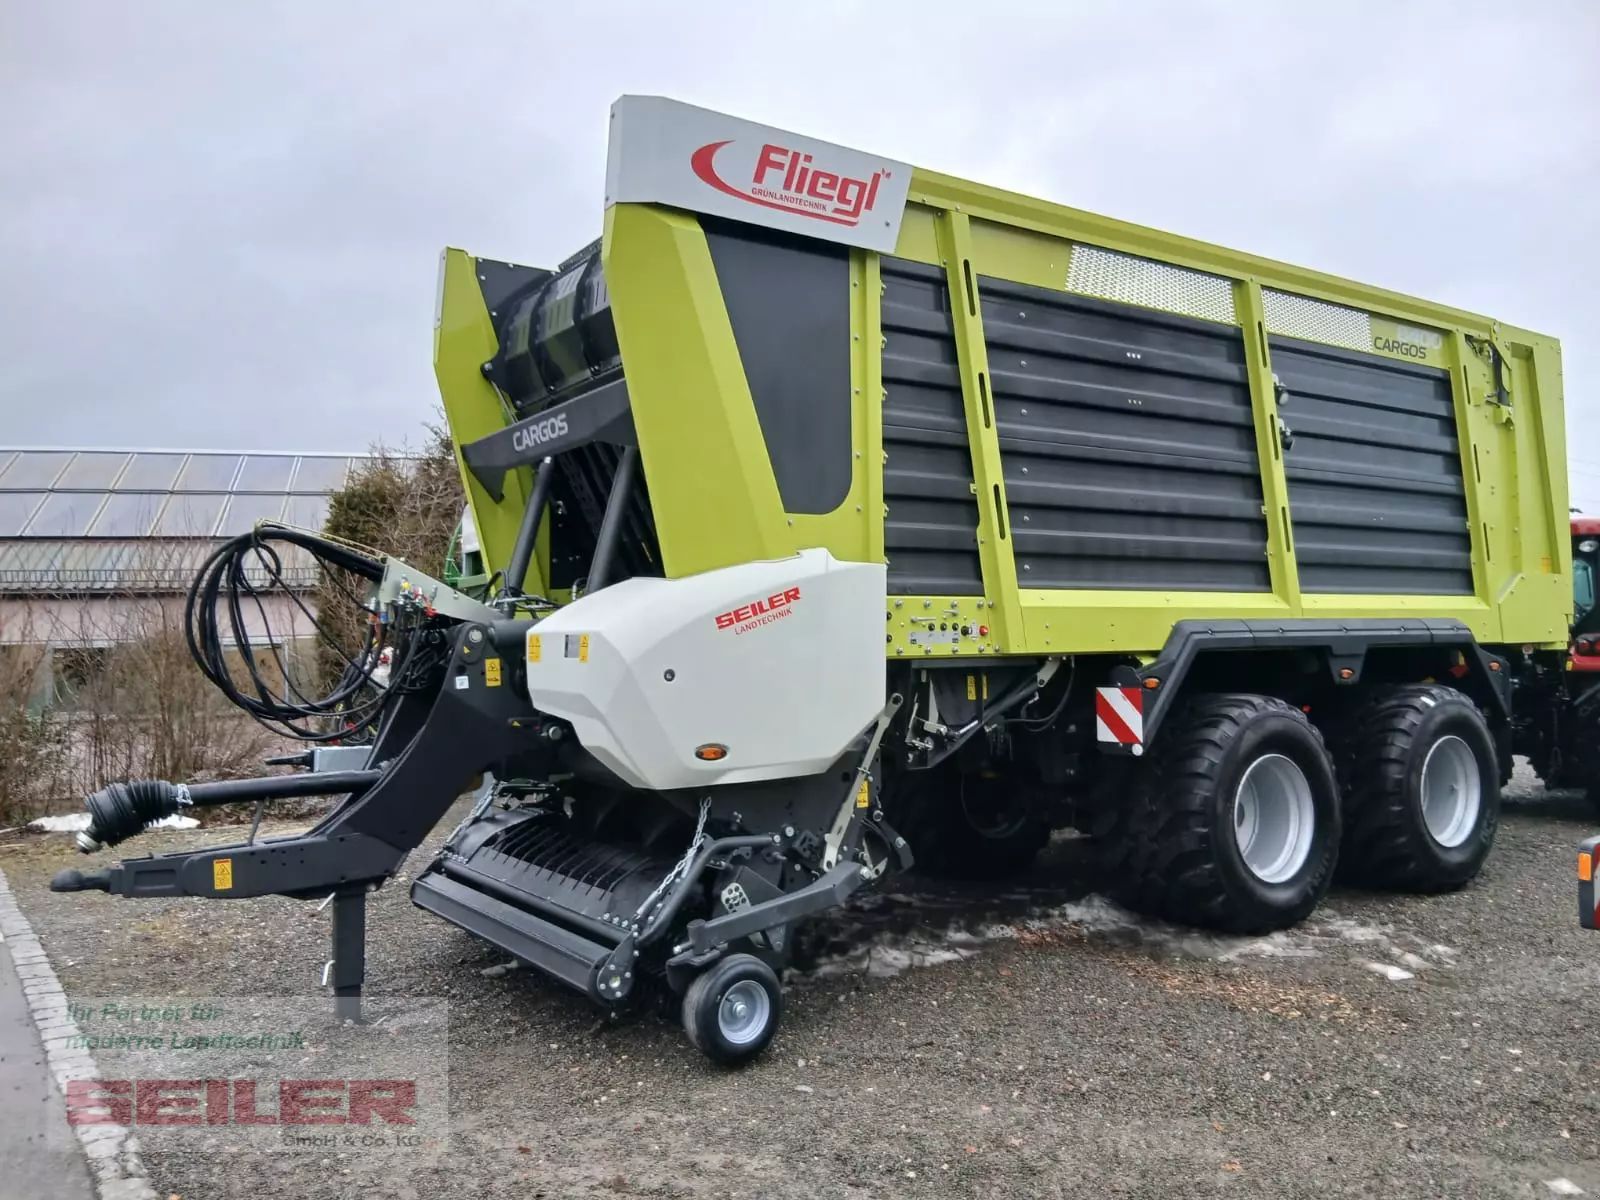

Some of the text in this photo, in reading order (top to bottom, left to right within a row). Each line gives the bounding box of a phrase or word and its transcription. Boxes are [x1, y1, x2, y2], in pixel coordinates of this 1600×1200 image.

[752, 143, 881, 218] Fliegl
[751, 187, 828, 212] GRÜNLANDTECHNIK
[1374, 337, 1426, 359] CARGOS
[512, 413, 568, 451] CARGOS
[715, 587, 800, 629] SEILER
[735, 607, 793, 635] LANDTECHNIK
